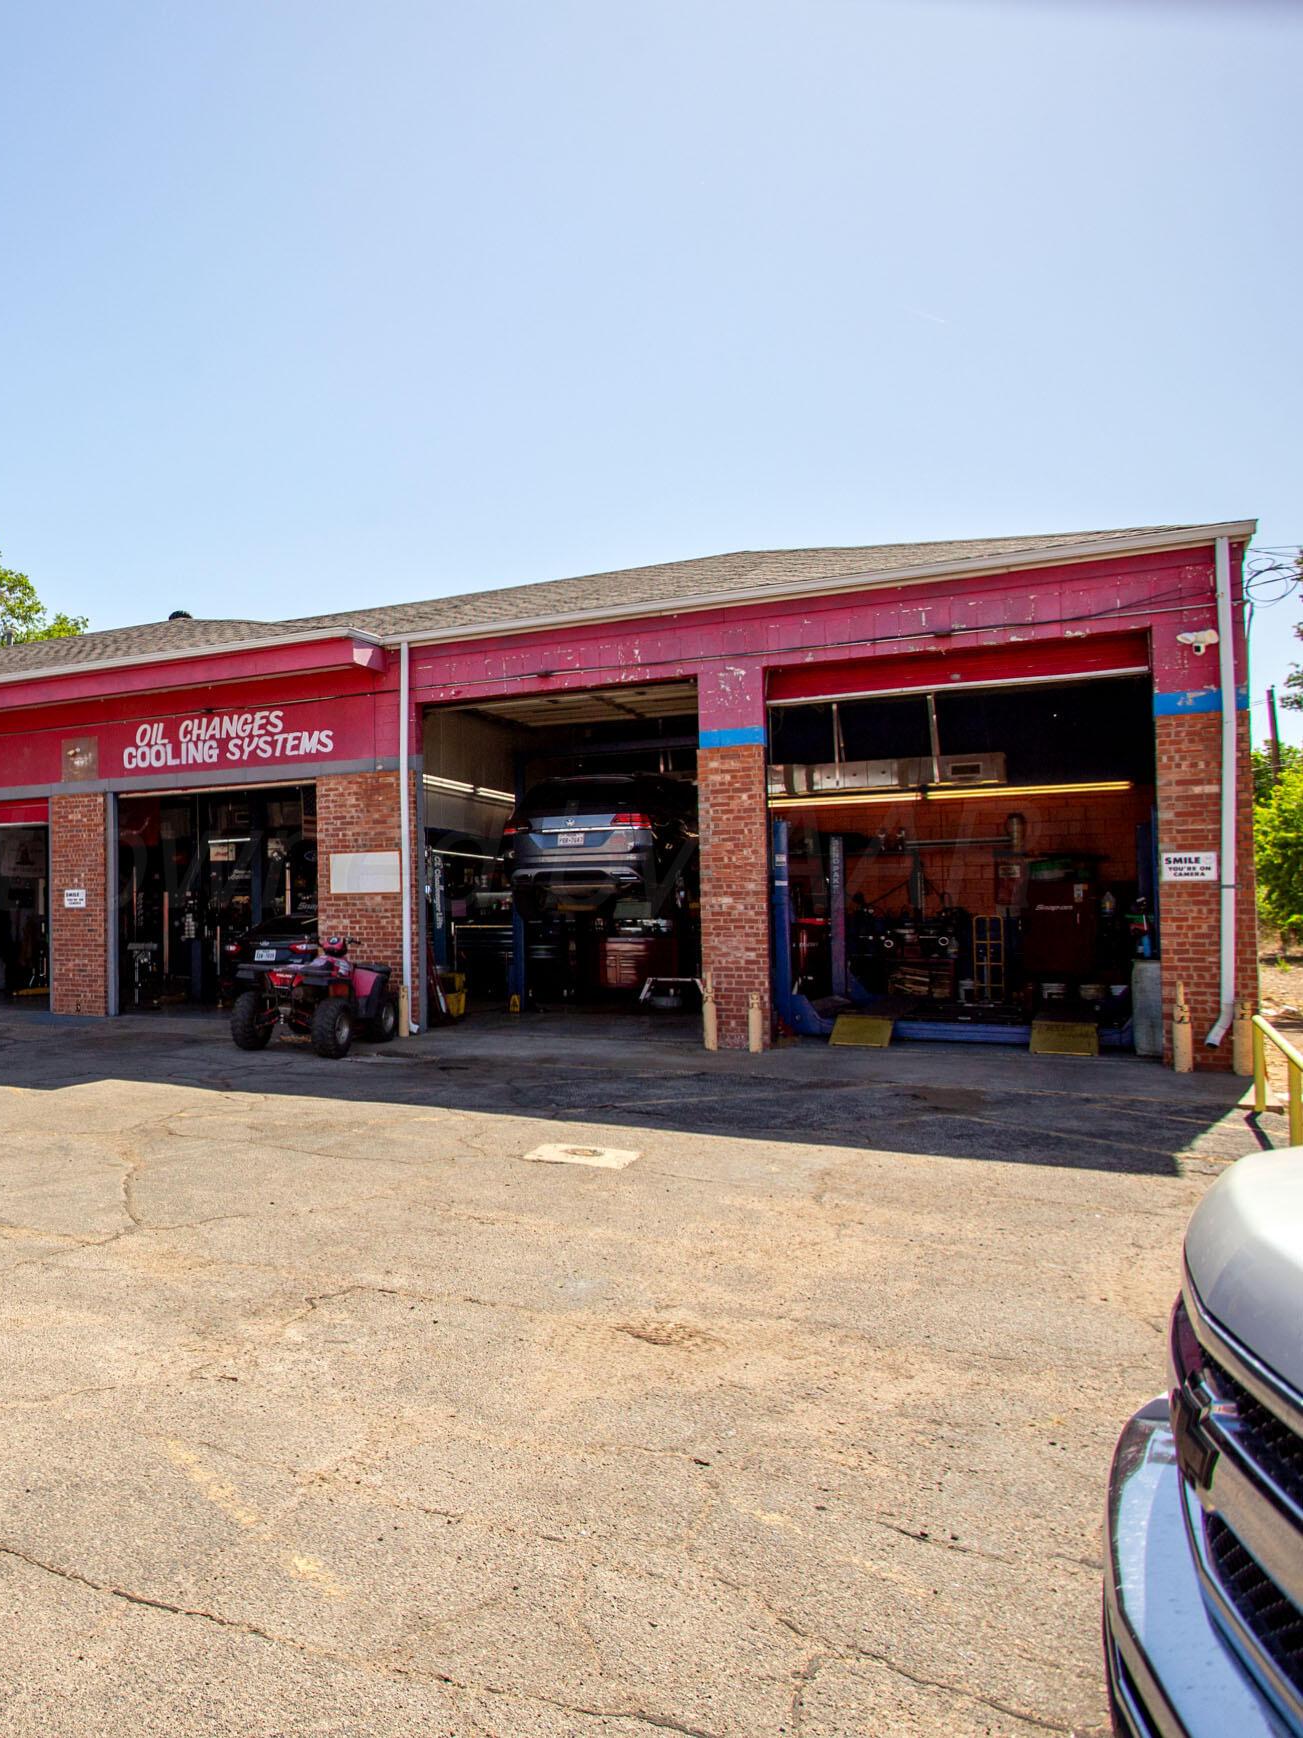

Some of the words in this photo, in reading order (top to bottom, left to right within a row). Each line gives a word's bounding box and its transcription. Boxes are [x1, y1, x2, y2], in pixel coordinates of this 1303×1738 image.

[135, 723, 169, 746] OIL
[179, 710, 284, 742] CHANGES
[123, 740, 219, 769] COOLING
[226, 730, 334, 760] SYSTEMS
